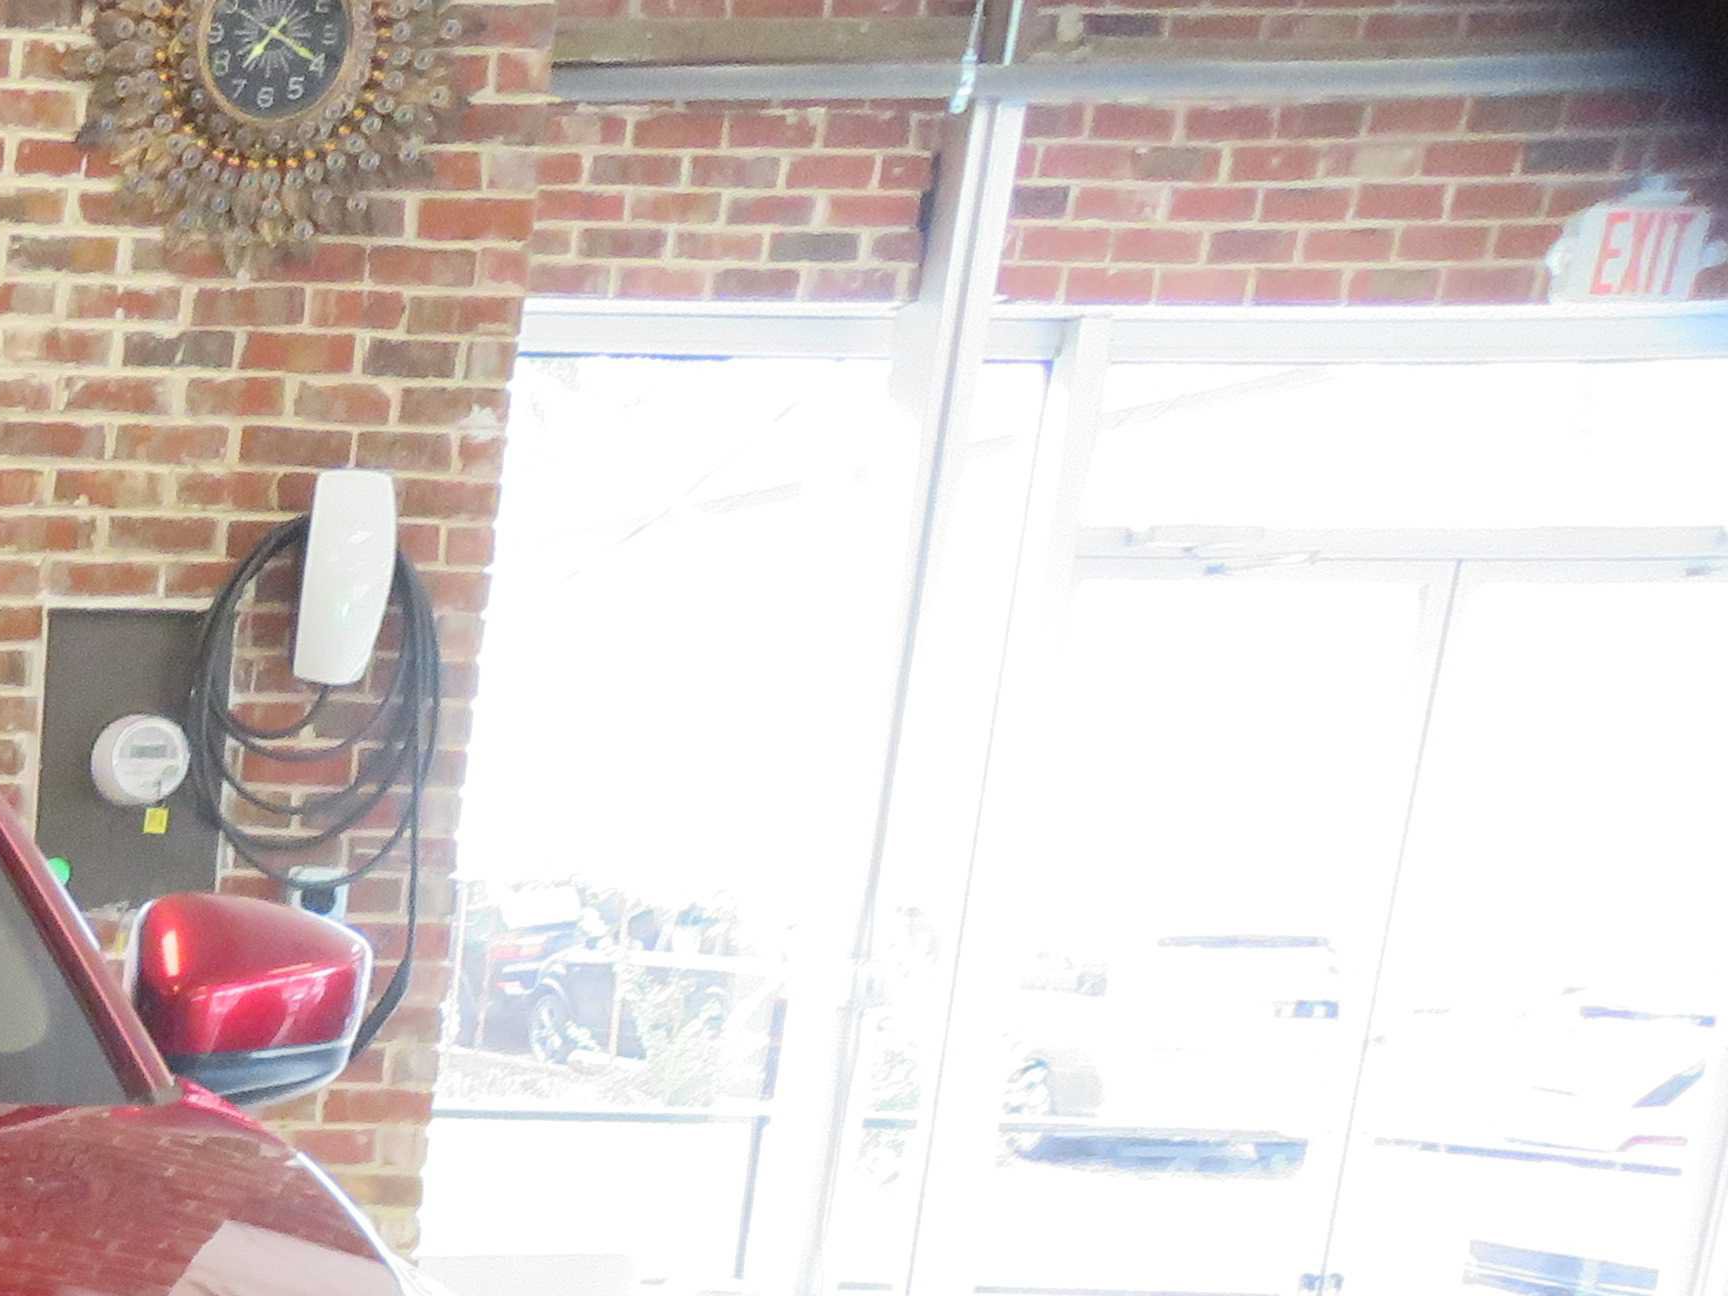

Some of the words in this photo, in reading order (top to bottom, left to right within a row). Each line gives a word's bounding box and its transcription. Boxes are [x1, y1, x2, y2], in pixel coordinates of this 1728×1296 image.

[308, 52, 327, 79] 4
[231, 78, 248, 100] 7
[256, 86, 275, 109] 6
[287, 75, 306, 100] 5
[1589, 212, 1693, 295] EXIT
